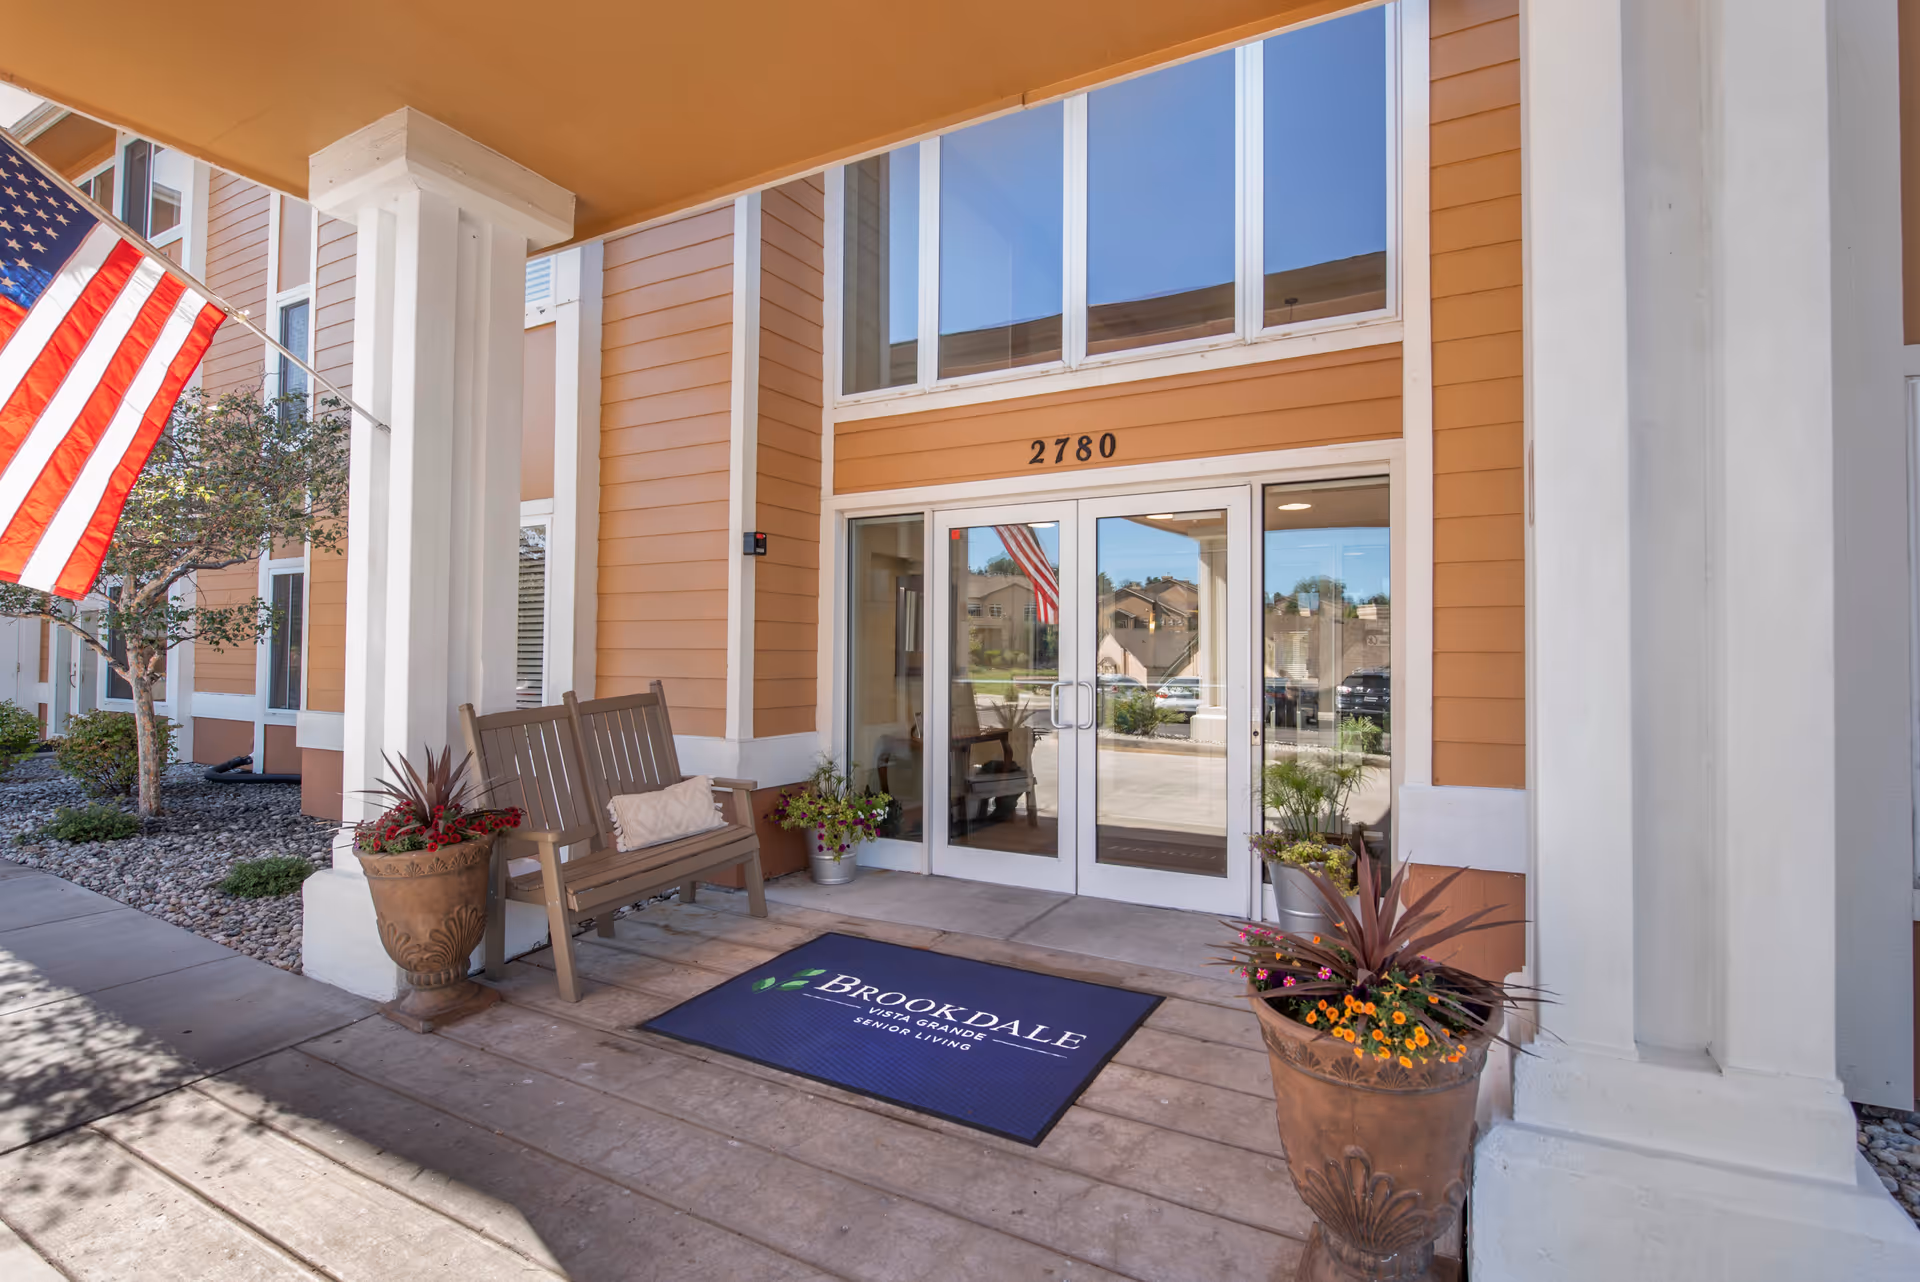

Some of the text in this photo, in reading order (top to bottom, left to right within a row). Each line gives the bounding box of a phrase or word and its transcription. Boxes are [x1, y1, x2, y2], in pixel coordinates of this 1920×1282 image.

[1028, 432, 1116, 464] 2780
[813, 973, 1087, 1050] BROOKDALE
[868, 1006, 987, 1041] VISTA GRANDE
[853, 1016, 971, 1051] SENIOR LIVING
